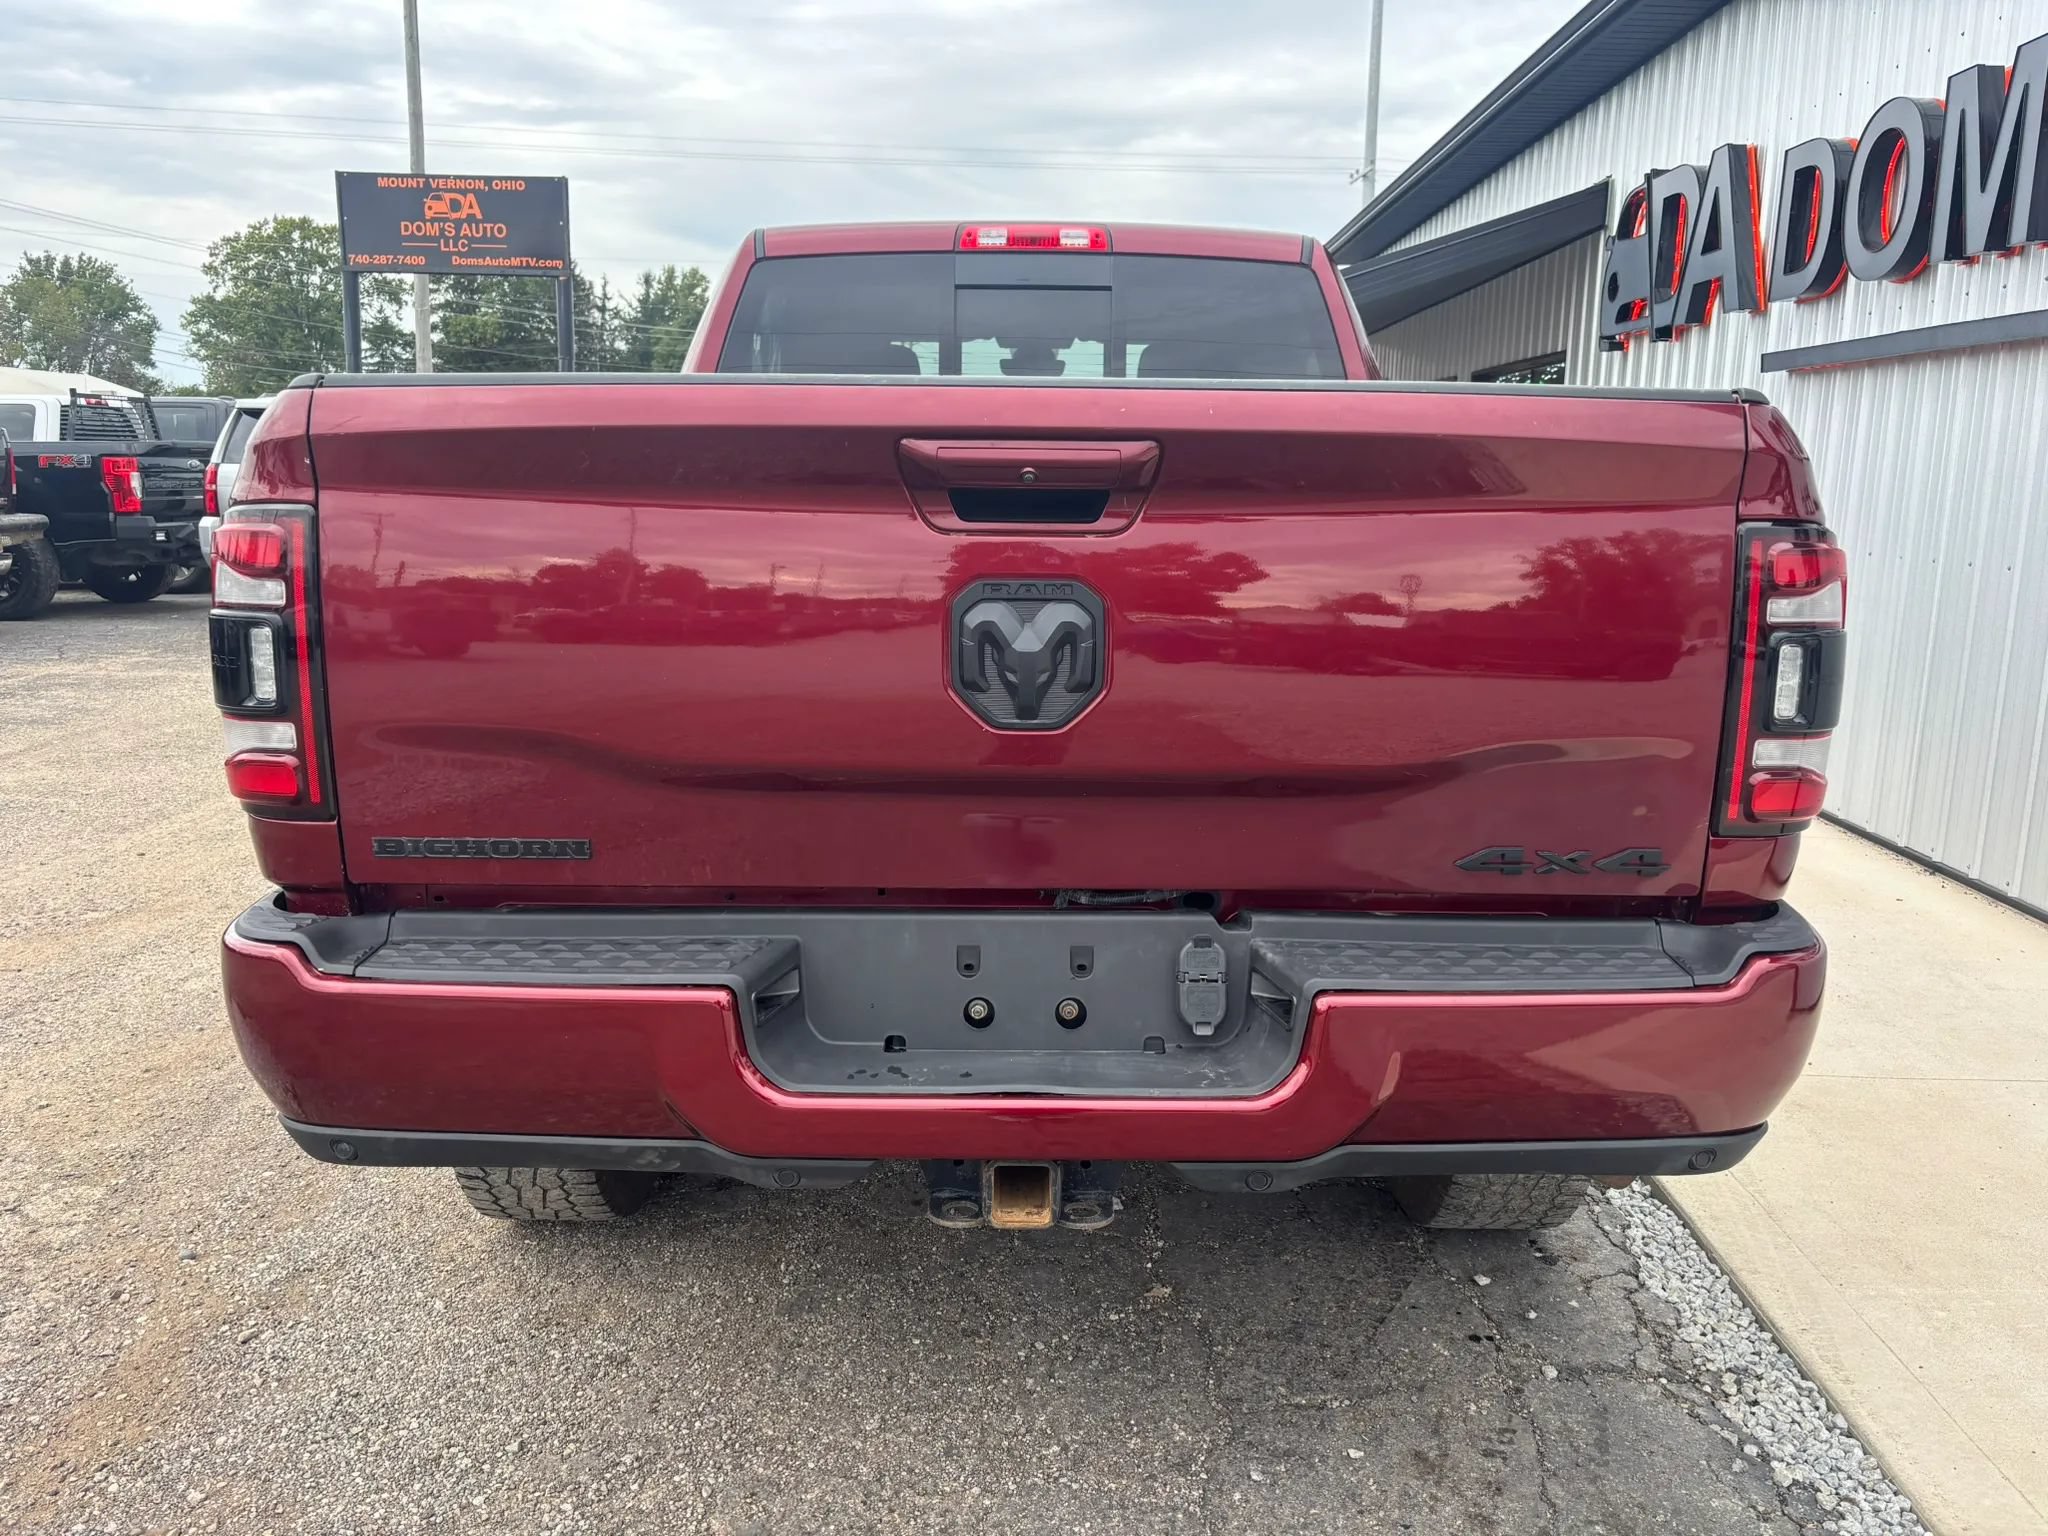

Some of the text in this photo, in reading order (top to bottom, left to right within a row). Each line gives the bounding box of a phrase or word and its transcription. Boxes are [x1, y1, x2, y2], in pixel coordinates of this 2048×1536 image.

[377, 177, 526, 191] MOUNT VERNON, OHIO
[400, 221, 507, 238] DOM'S AUTO
[439, 239, 469, 252] LLC
[348, 254, 564, 269] 740-287-7400 DomsAutoMTV.com
[38, 453, 92, 469] FX4
[982, 583, 1074, 596] RAM
[372, 836, 592, 859] BIGHORN
